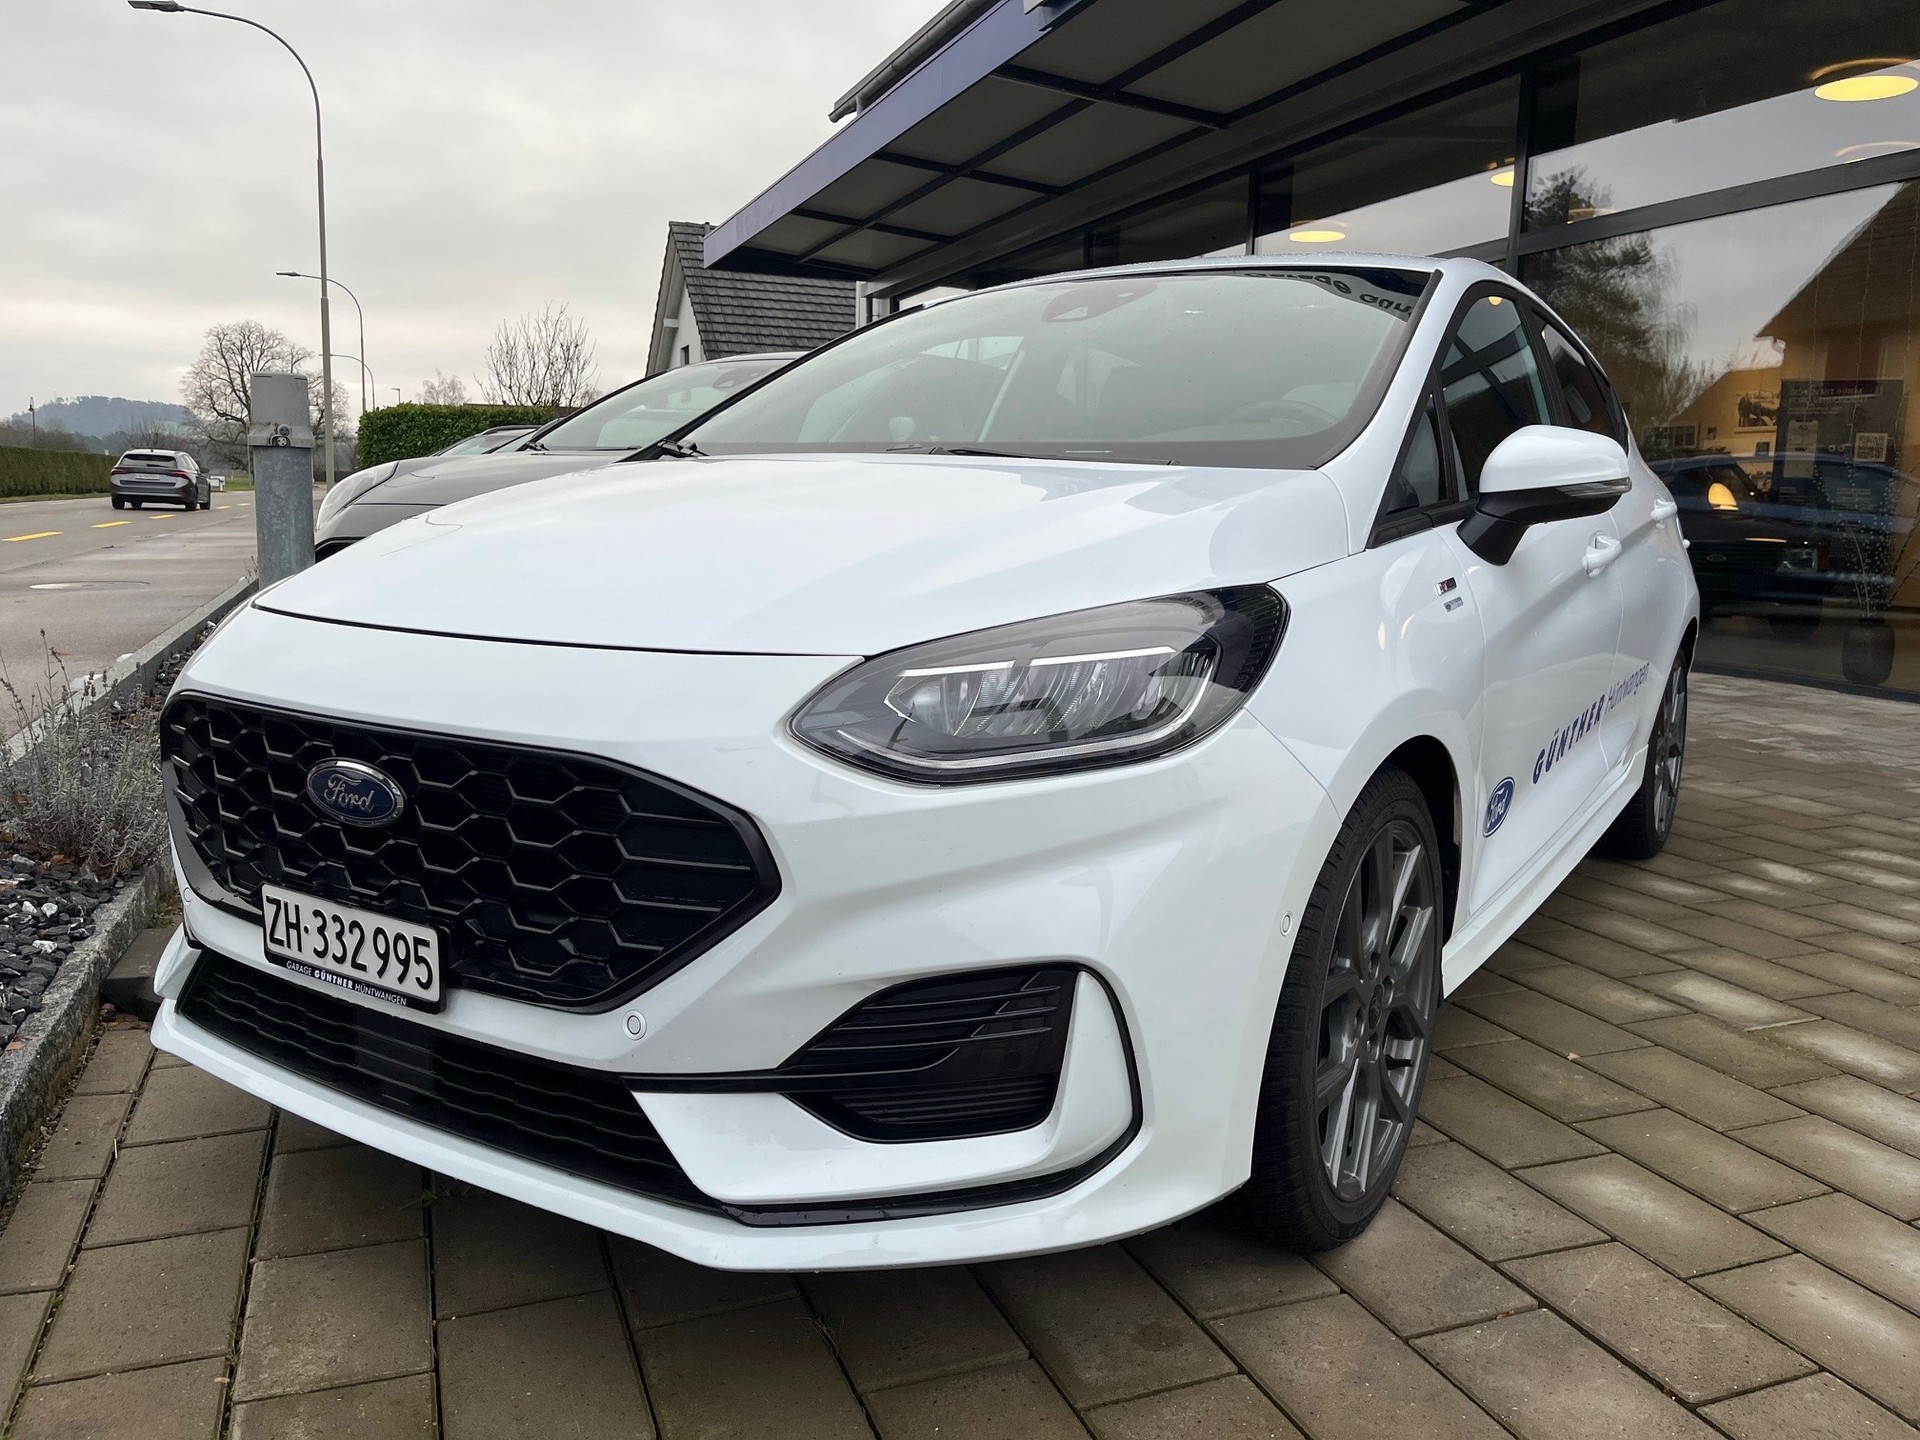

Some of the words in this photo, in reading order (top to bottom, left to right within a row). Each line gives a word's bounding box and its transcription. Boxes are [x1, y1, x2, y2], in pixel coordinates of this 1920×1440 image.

[1533, 694, 1606, 784] GÜNTHER
[324, 773, 375, 813] Ford
[286, 960, 312, 976] GARAGE
[314, 969, 353, 989] GÜNTHER
[354, 983, 407, 1006] HÜNTWANGEN
